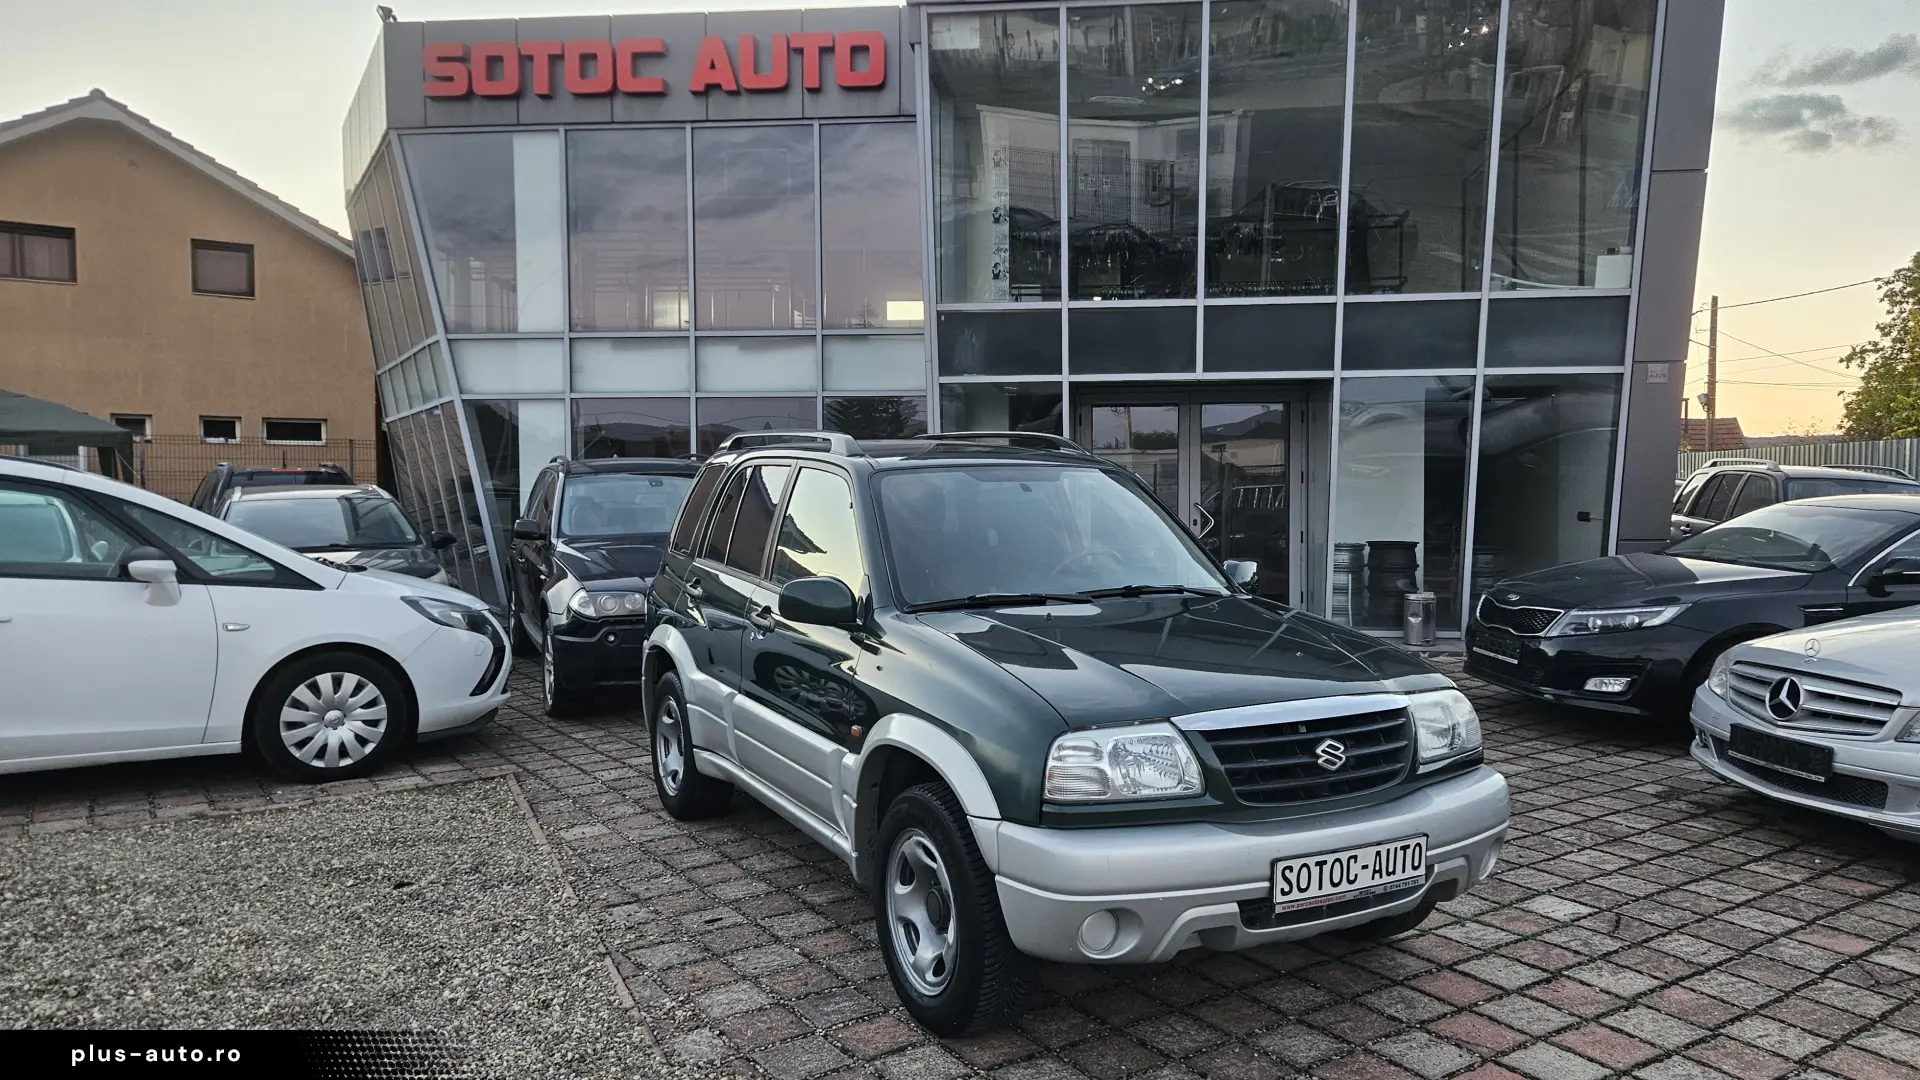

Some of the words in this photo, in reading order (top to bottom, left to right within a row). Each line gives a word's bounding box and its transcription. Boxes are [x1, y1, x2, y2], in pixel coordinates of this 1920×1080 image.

[423, 38, 668, 98] SOTOC
[689, 30, 887, 96] AUTO
[1280, 842, 1423, 897] SOTOC-AUTO
